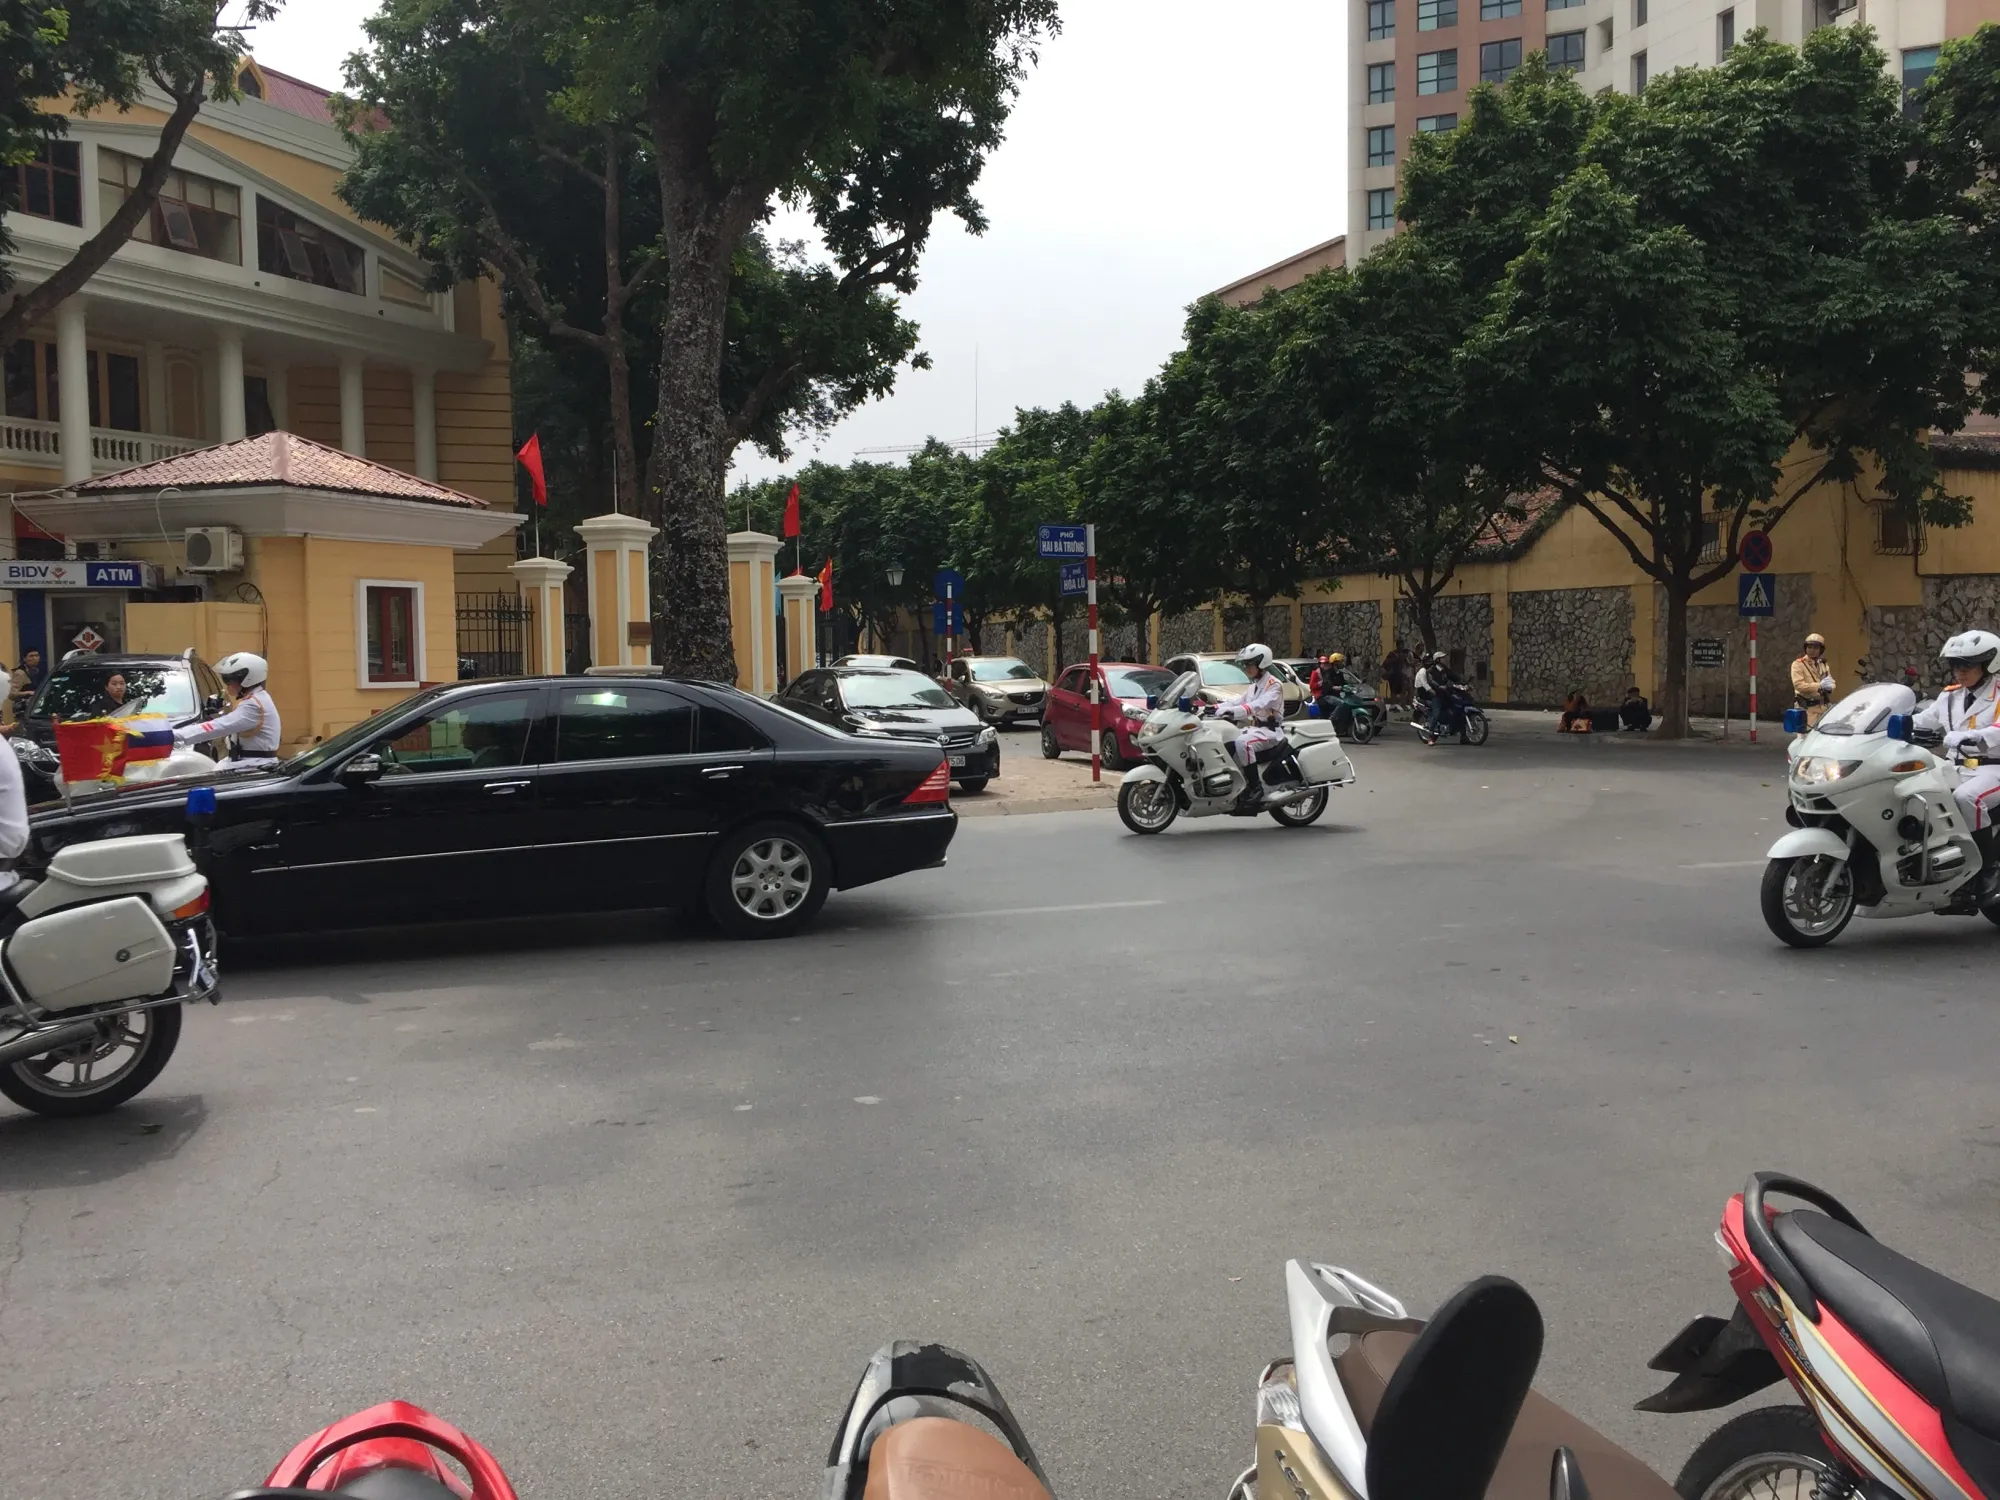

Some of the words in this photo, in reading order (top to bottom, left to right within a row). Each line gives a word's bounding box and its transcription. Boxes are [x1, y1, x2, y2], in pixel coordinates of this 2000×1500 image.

[1042, 541, 1053, 552] HAI
[1054, 539, 1063, 552] BÀ
[1064, 541, 1084, 552] TRƯNG
[9, 566, 49, 577] BIDV
[95, 568, 134, 581] ATM
